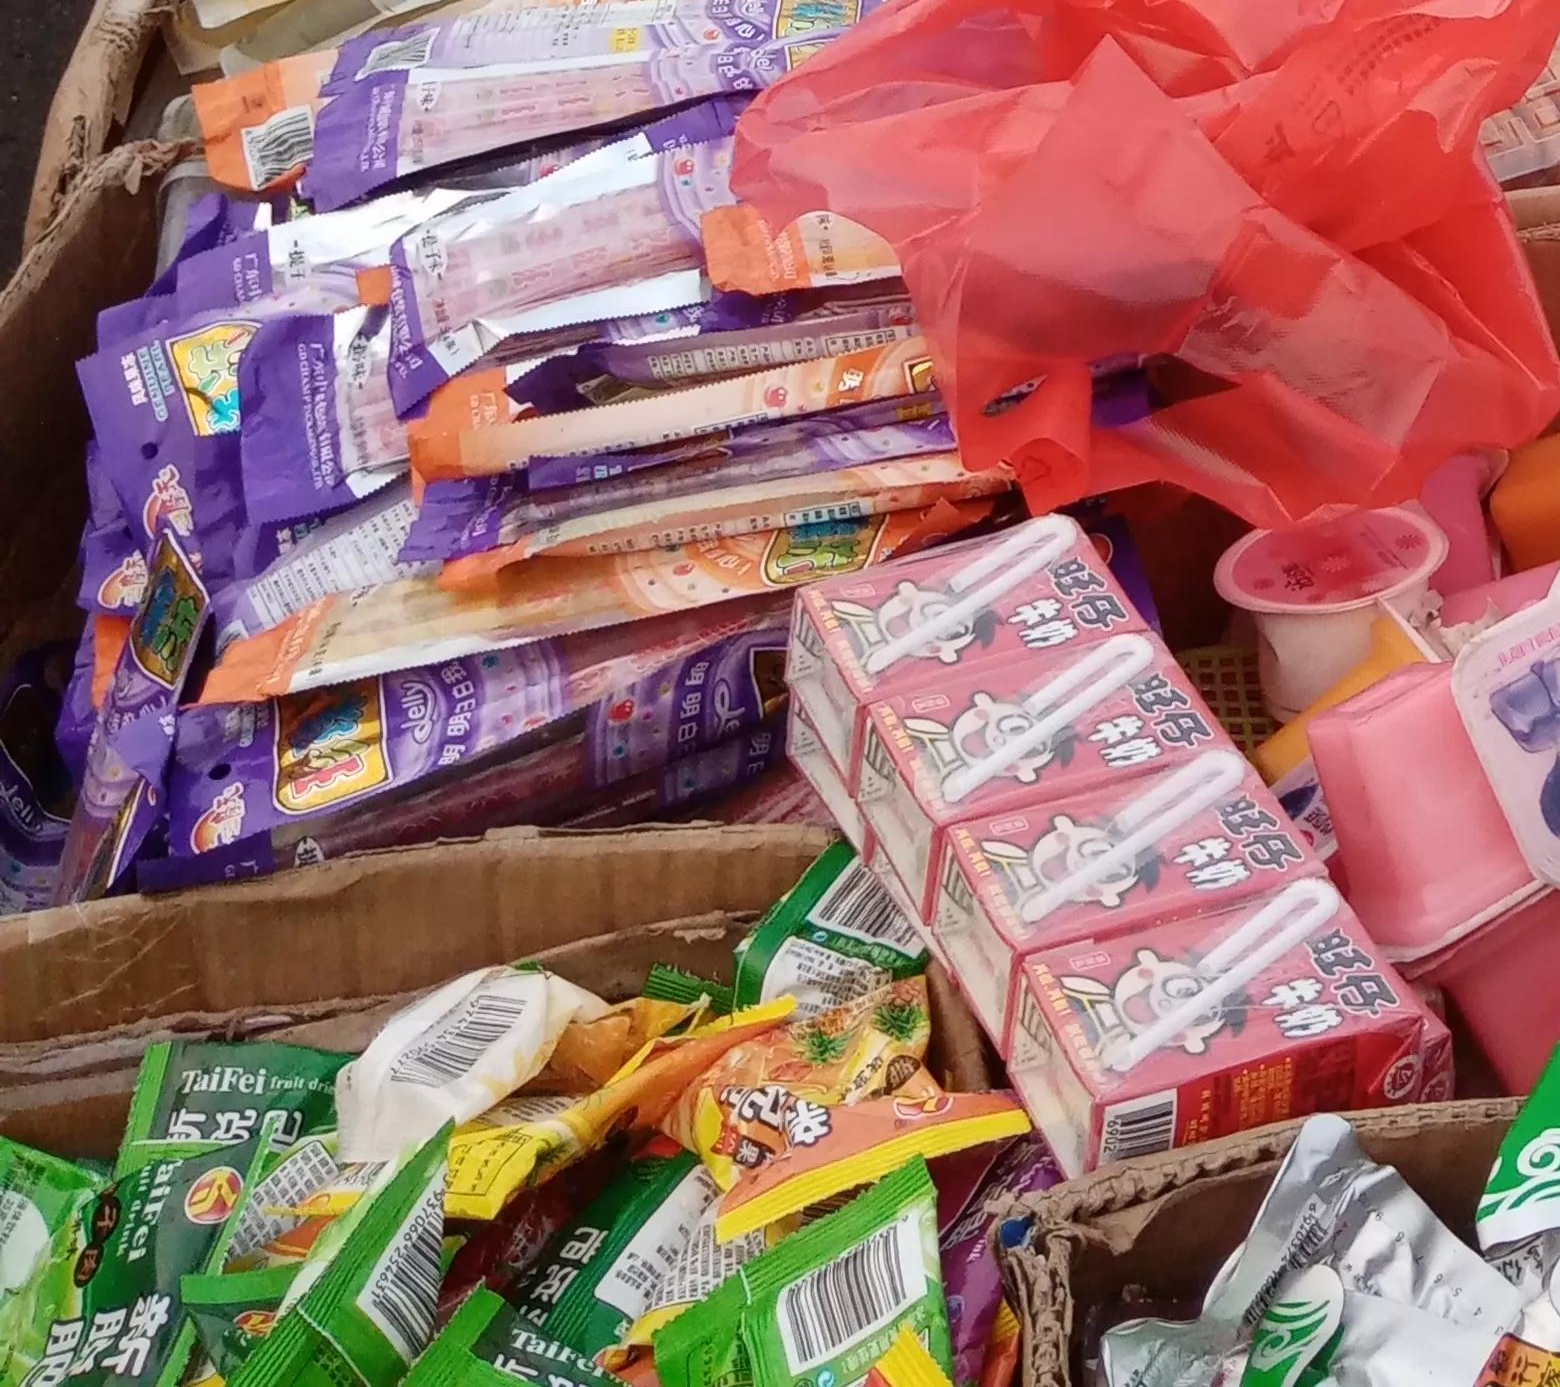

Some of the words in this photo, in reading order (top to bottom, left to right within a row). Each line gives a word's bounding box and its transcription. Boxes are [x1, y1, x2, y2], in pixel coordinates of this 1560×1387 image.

[1047, 556, 1130, 629] 旺仔
[1007, 597, 1081, 649] 牛奶
[401, 672, 435, 744] Jelly
[1129, 673, 1216, 748] 旺仔
[1087, 715, 1163, 768] 牛奶
[1215, 794, 1305, 870] 旺仔
[1172, 836, 1253, 890] 牛奶
[1307, 931, 1401, 1017] 旺仔
[1261, 979, 1345, 1038] 牛奶
[181, 1067, 265, 1095] TaiFei
[269, 1075, 304, 1092] fruit
[305, 1077, 336, 1095] drin
[1103, 1117, 1121, 1157] 6902
